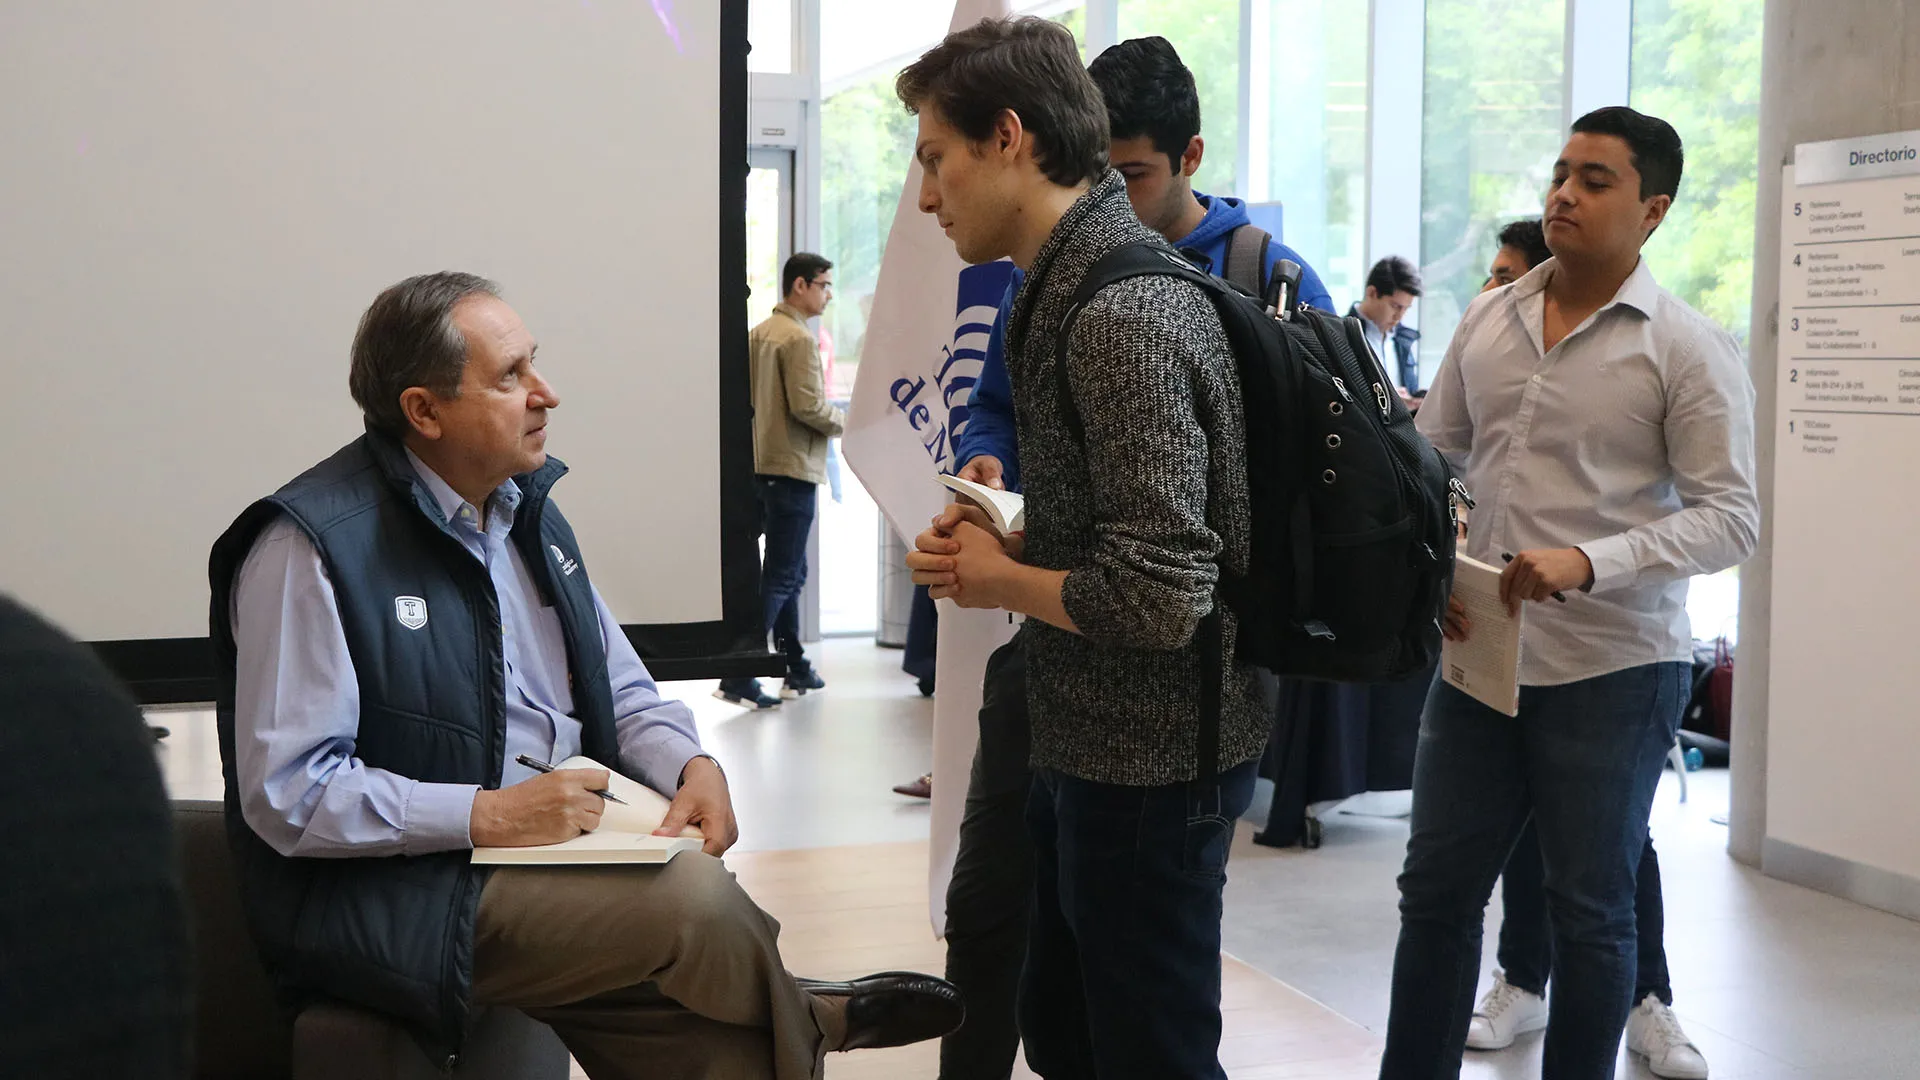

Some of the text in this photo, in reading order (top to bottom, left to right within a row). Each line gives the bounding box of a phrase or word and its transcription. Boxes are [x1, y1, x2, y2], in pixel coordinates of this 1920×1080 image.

[1850, 145, 1916, 166] Directorio
[1794, 203, 1802, 216] 5
[1839, 211, 1863, 219] General
[1793, 254, 1801, 267] 4
[1791, 318, 1799, 331] 3
[1790, 368, 1798, 383] 2
[890, 375, 930, 431] de
[1789, 420, 1794, 433] 1
